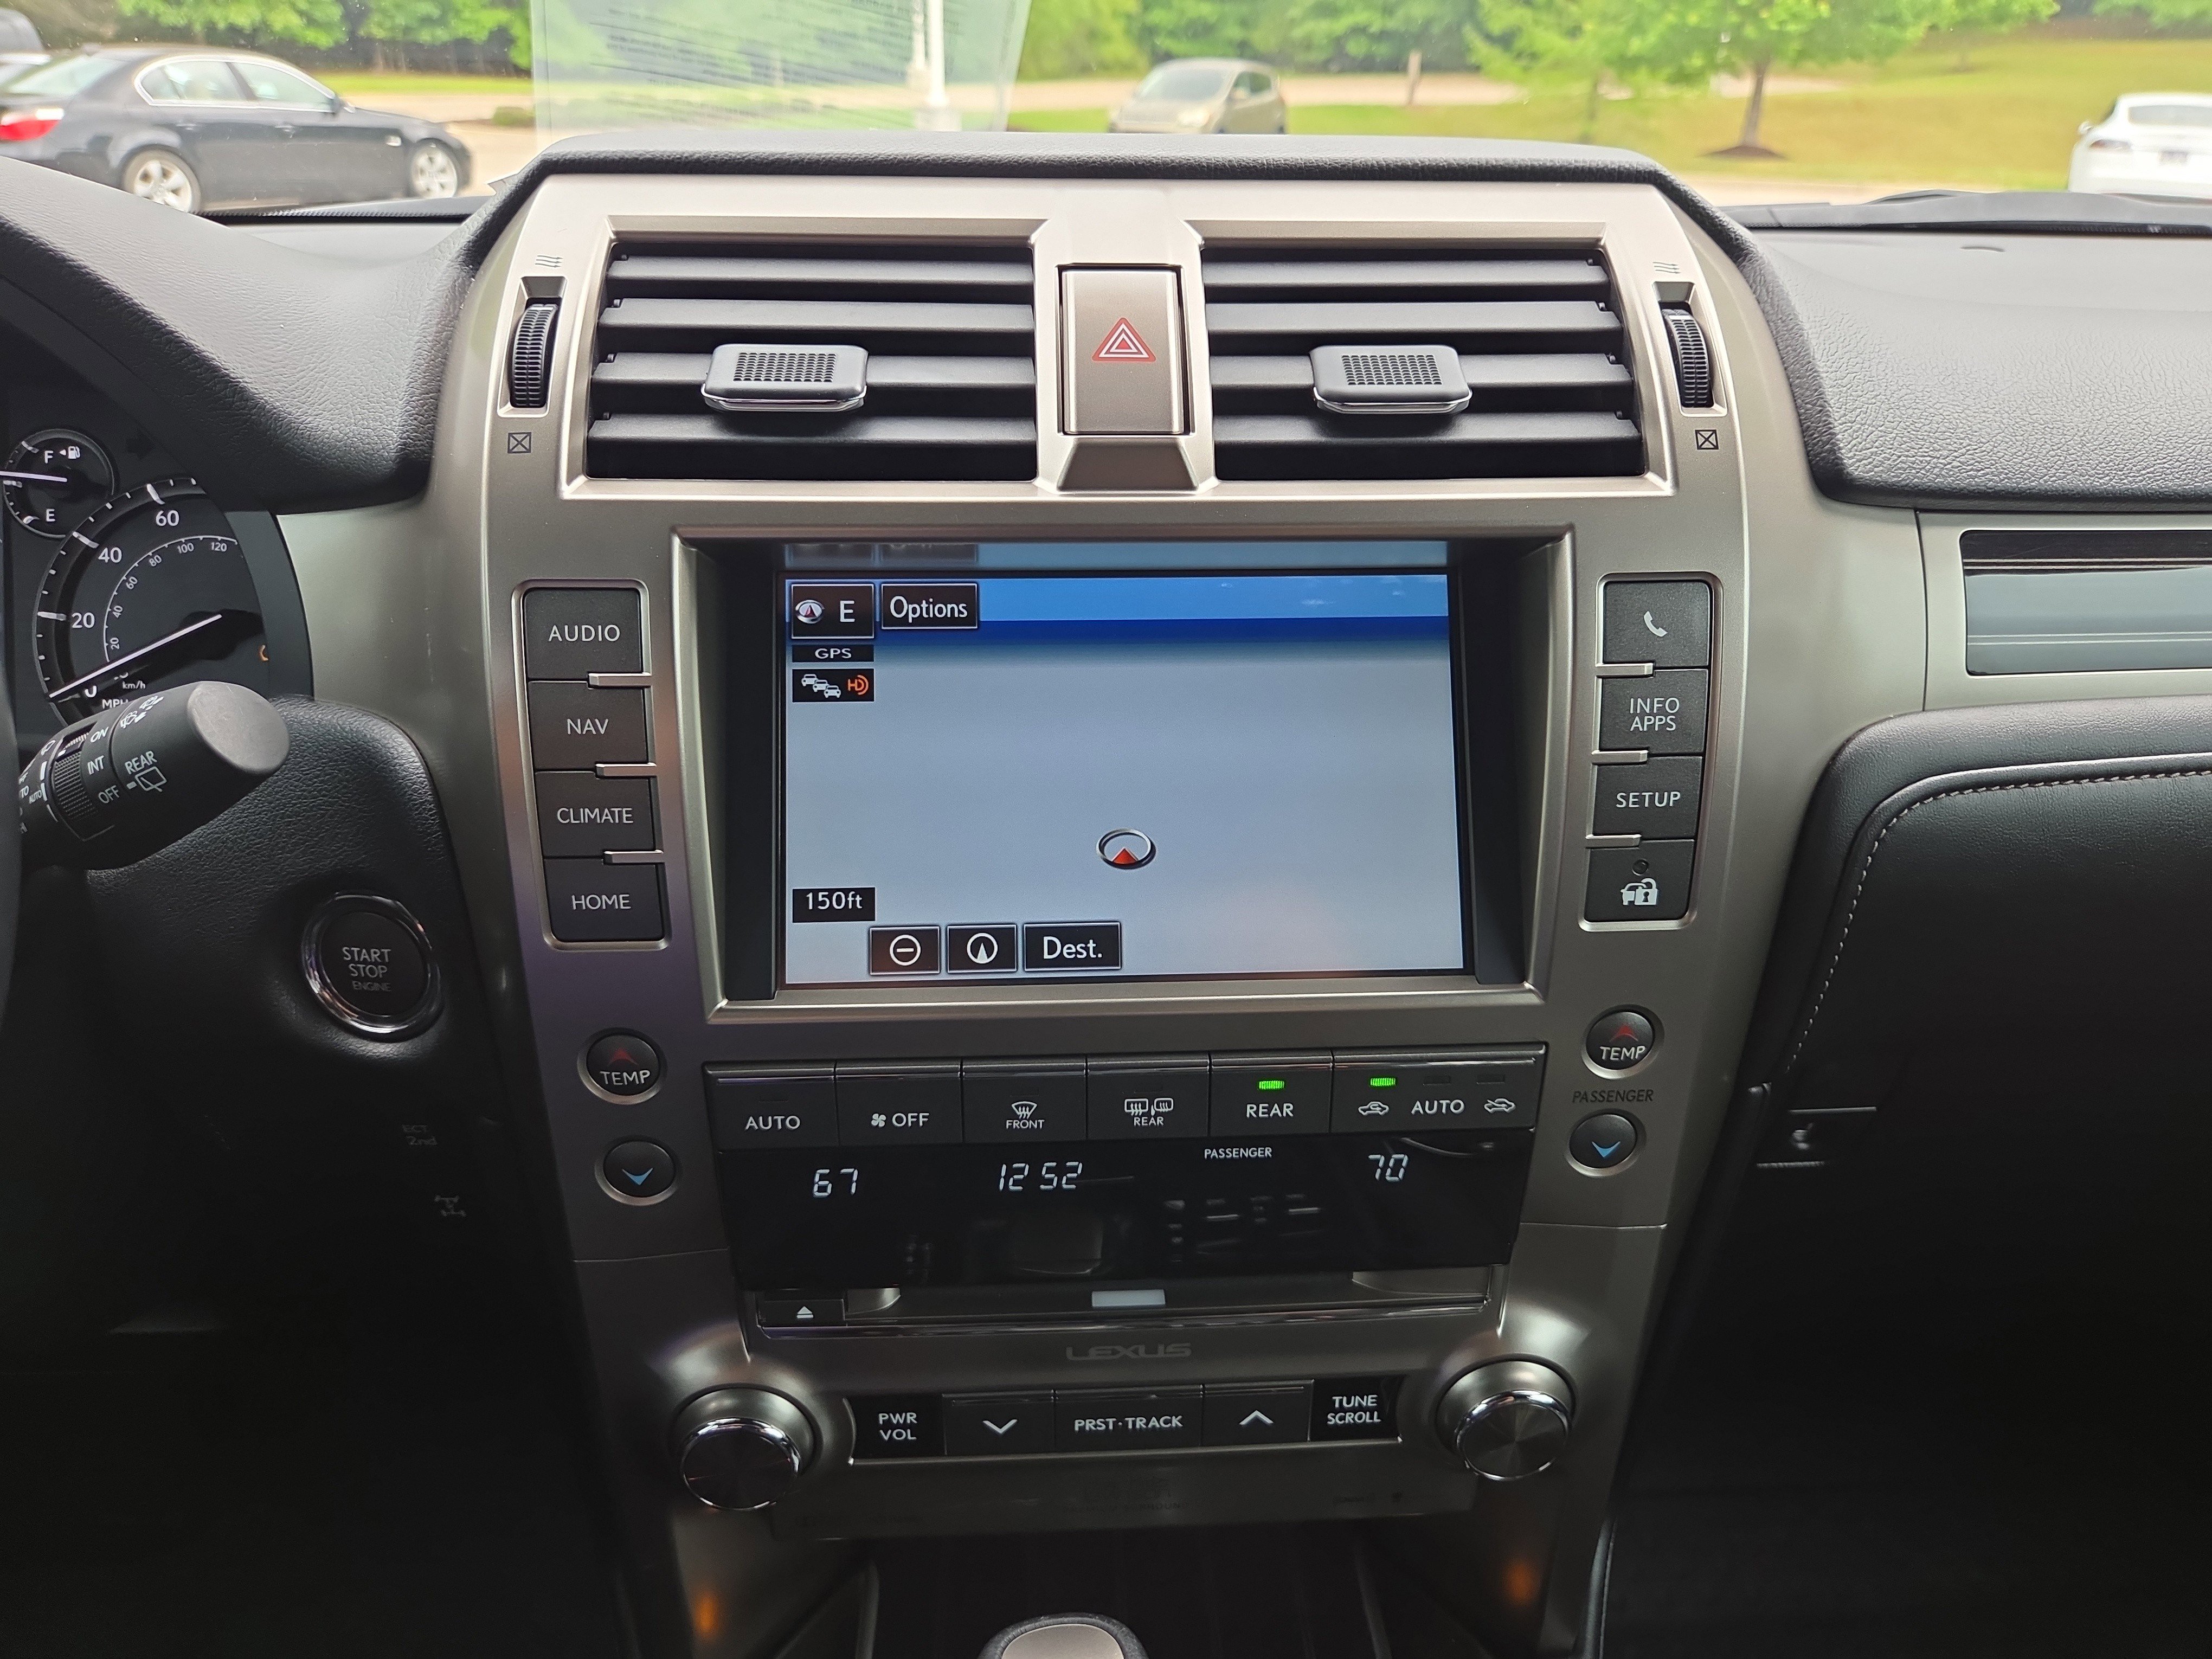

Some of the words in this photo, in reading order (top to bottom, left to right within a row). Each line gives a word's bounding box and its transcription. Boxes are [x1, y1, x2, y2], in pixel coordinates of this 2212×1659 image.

[44, 450, 54, 464] F
[46, 509, 56, 522] E
[156, 510, 179, 526] 60
[177, 542, 194, 554] 100
[211, 542, 227, 552] 120
[98, 547, 122, 563] 40
[148, 555, 162, 567] 80
[125, 576, 138, 590] 60
[112, 605, 123, 618] 40
[840, 600, 855, 622] E
[890, 596, 968, 623] Options
[72, 612, 95, 628] 20
[548, 624, 620, 641] AUDIO
[111, 637, 120, 650] 20
[815, 648, 852, 659] GPS
[122, 680, 146, 689] km/h
[1630, 697, 1680, 714] INFO
[567, 718, 609, 735] NAV
[1630, 715, 1676, 731] APPS
[90, 726, 109, 743] ON
[87, 755, 104, 775] INT
[124, 750, 158, 775] REAR
[98, 785, 119, 803] OFF
[1616, 791, 1681, 808] SETUP
[557, 807, 634, 824] CLIMATE
[571, 894, 631, 910] HOME
[806, 891, 863, 910] 150ft
[342, 947, 391, 962] START
[1043, 936, 1102, 959] Dest.
[348, 963, 388, 978] STOP
[1600, 1045, 1646, 1061] TEMP
[600, 1070, 651, 1085] TEMP
[1572, 1089, 1654, 1103] PASSENGER
[1246, 1103, 1294, 1118] REAR
[1411, 1099, 1464, 1114] AUTO
[745, 1115, 800, 1130] AUTO
[892, 1113, 929, 1127] OFF
[1006, 1119, 1045, 1129] FRONT
[1134, 1116, 1164, 1126] REAR
[1204, 1147, 1272, 1159] PASSENGER
[1368, 1154, 1409, 1181] 70
[813, 1168, 858, 1197] 67
[1066, 1342, 1192, 1361] LEXUS
[1332, 1394, 1378, 1408] TUNE
[878, 1412, 917, 1425] PWR
[1327, 1411, 1381, 1425] SCROLL
[879, 1429, 917, 1441] VOL
